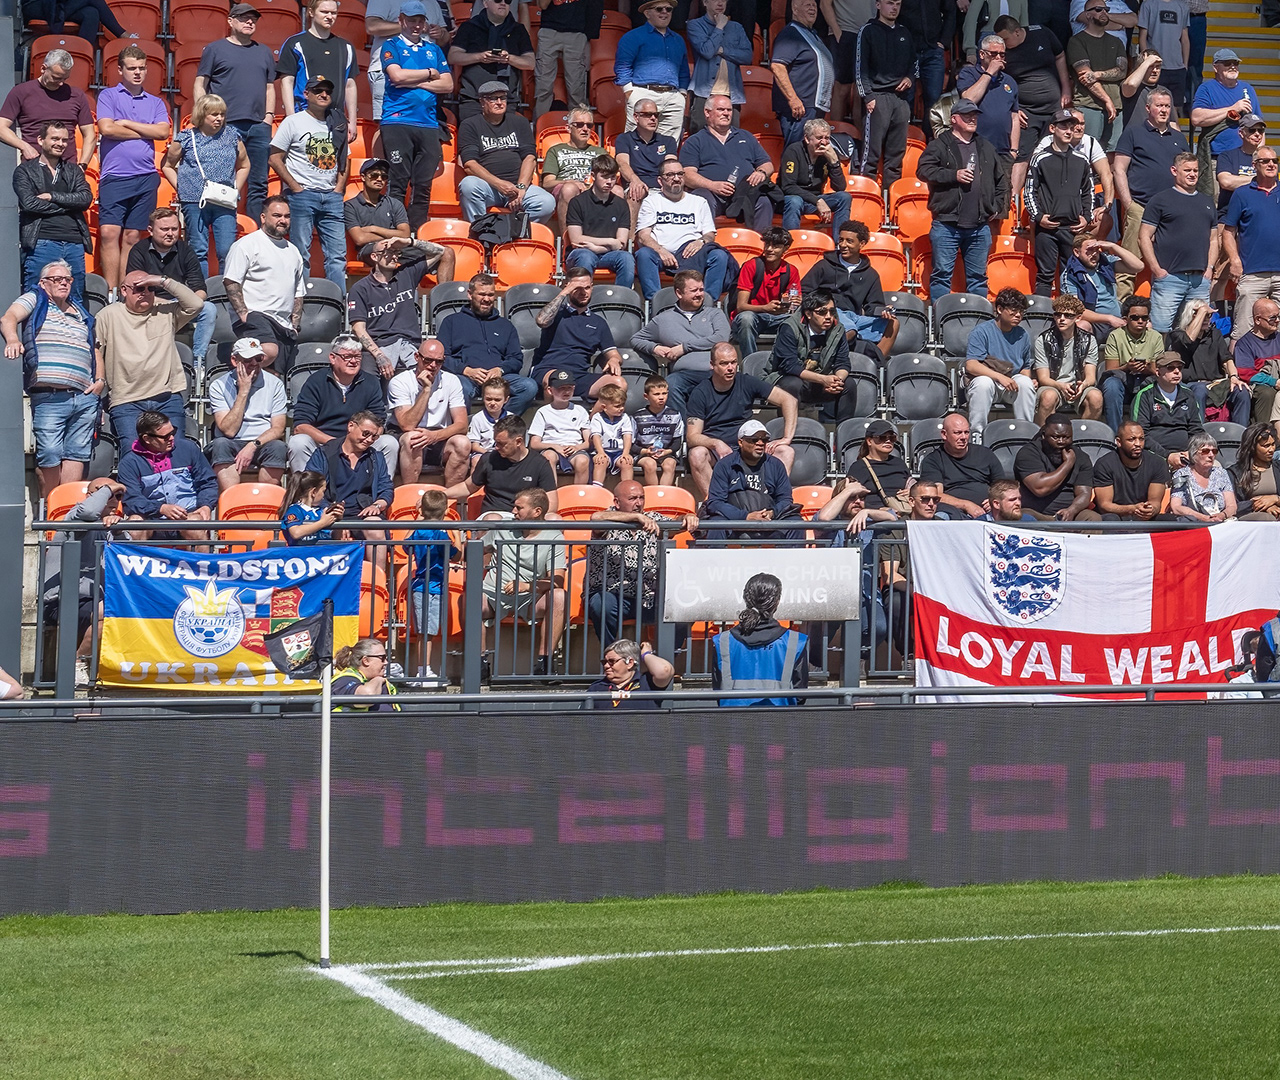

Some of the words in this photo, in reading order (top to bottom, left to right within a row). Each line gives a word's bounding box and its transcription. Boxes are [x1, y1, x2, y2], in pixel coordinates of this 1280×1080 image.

[786, 161, 795, 174] 3
[607, 438, 619, 449] 10
[116, 554, 351, 580] WEALDSTONE
[707, 565, 852, 582] WHECHAIR
[734, 587, 828, 604] VING
[936, 616, 1087, 684] LOYAL
[119, 661, 313, 686] UKRAI
